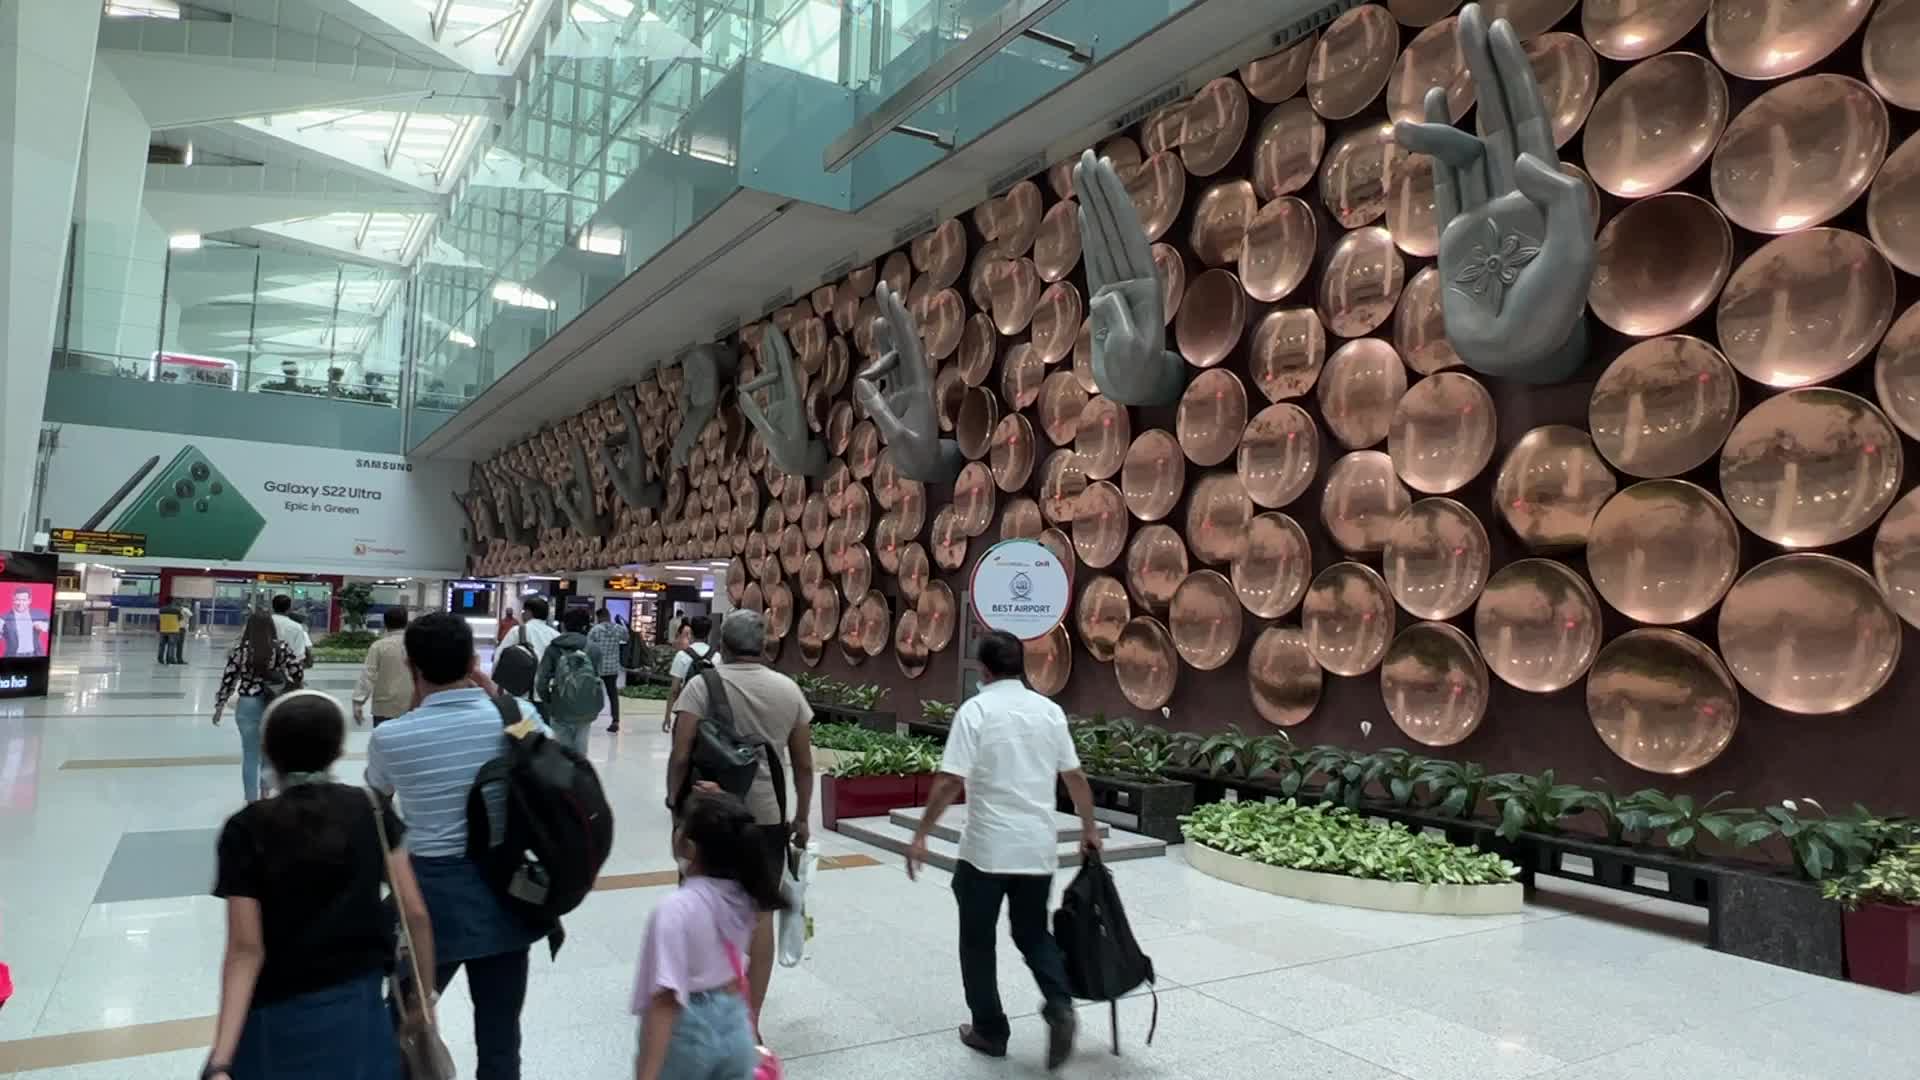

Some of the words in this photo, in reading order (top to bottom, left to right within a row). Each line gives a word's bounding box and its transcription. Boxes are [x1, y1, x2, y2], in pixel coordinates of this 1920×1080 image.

[357, 459, 413, 472] SAMSUNG
[264, 481, 319, 498] Galaxy
[322, 485, 346, 498] S22
[349, 488, 382, 500] Ultra
[285, 501, 309, 512] Epic
[311, 502, 321, 512] in
[324, 504, 359, 515] Green
[992, 604, 1013, 612] BEST
[1014, 604, 1050, 612] AIRPORT
